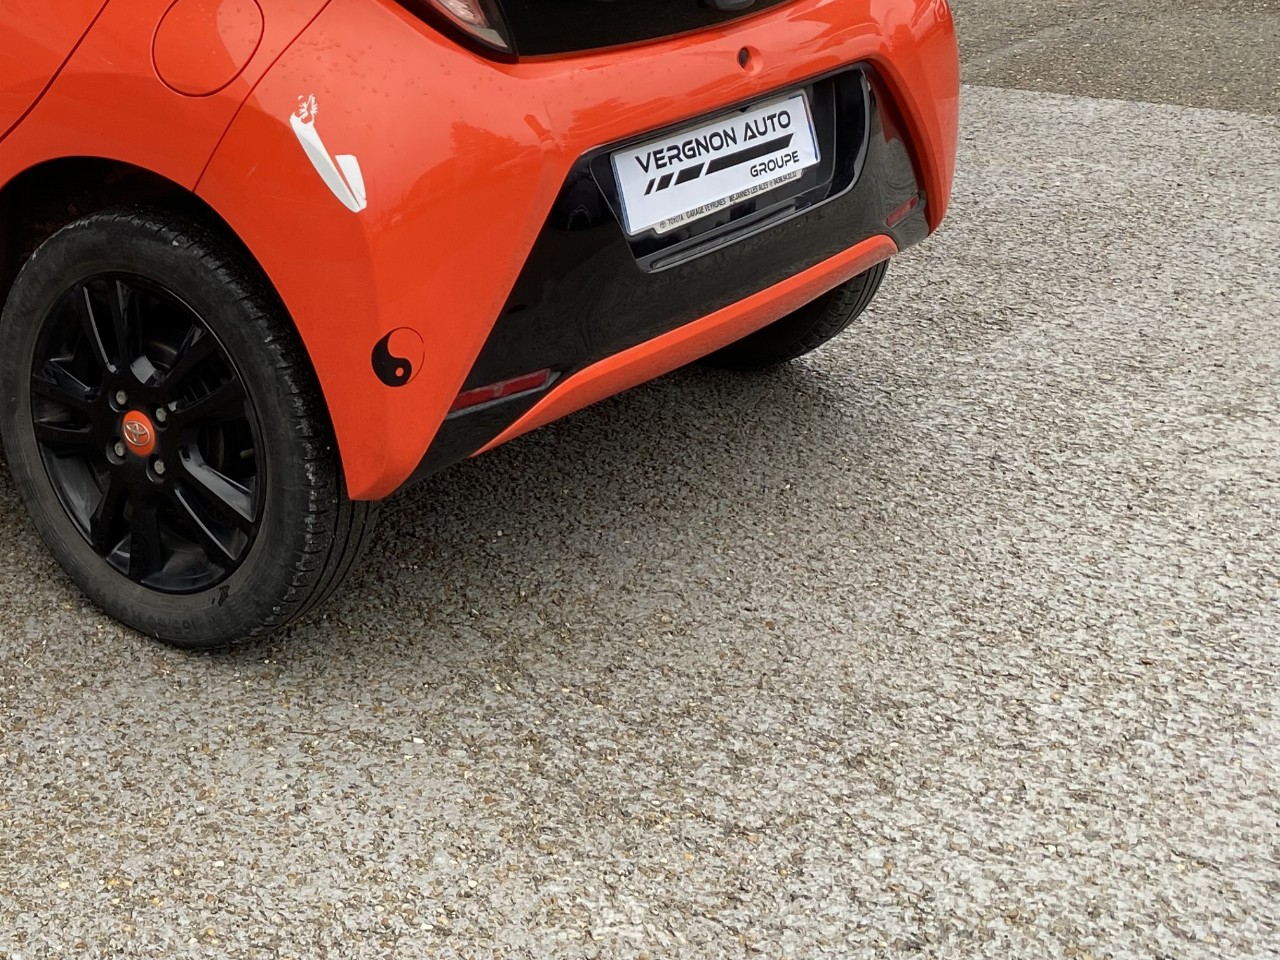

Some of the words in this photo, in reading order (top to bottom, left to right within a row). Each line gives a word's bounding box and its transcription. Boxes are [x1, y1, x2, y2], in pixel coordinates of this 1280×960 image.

[634, 126, 738, 174] VERGNON
[743, 109, 792, 142] AUTO
[749, 150, 800, 178] GROUPE
